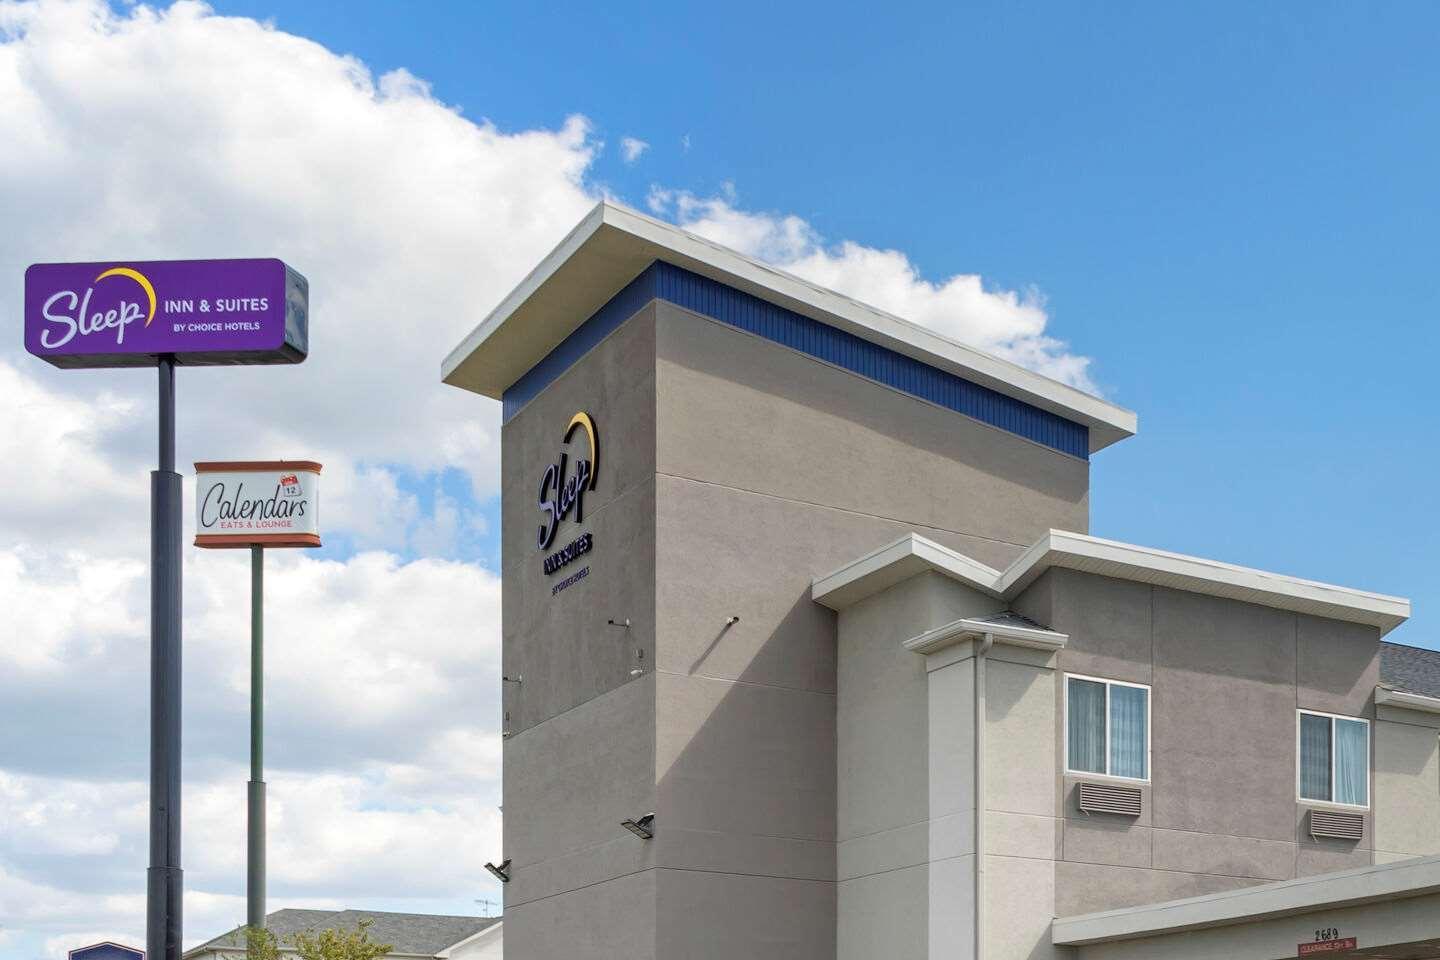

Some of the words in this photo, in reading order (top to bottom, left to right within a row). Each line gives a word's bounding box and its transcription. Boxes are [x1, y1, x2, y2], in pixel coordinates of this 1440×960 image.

[165, 300, 193, 313] INN
[199, 299, 211, 313] &
[216, 297, 269, 312] SUITES
[40, 287, 145, 348] Sleep
[173, 323, 186, 332] BY
[188, 322, 223, 332] CHOICE
[224, 321, 260, 331] HOTELS
[201, 482, 307, 528] Calendars
[537, 452, 591, 551] Sleep
[220, 520, 244, 529] EATS
[256, 519, 293, 529] LOUNGE
[1315, 928, 1339, 941] 2689
